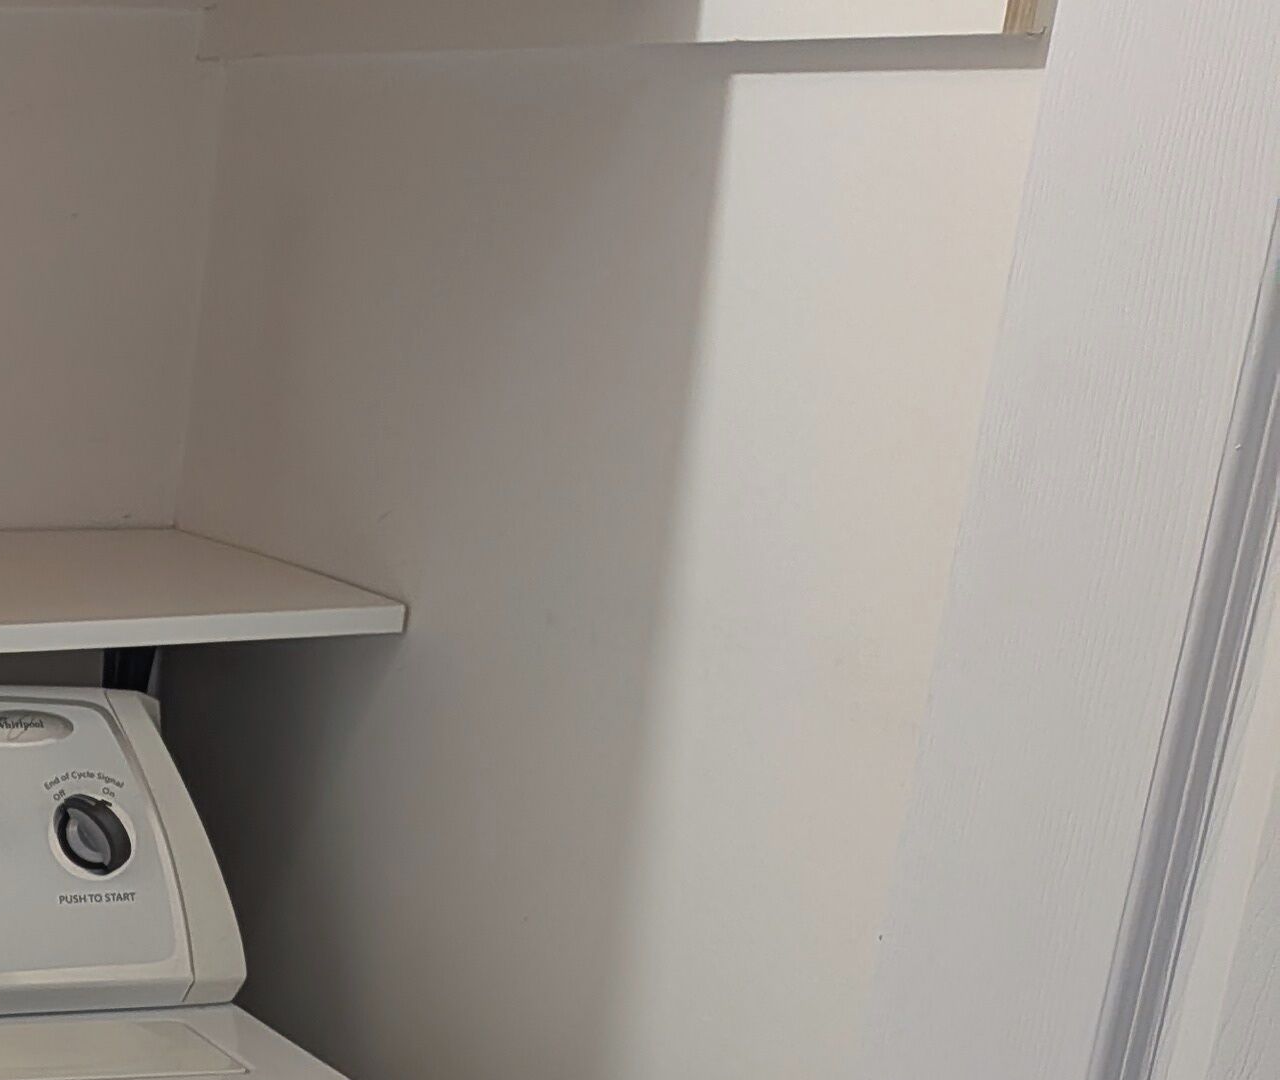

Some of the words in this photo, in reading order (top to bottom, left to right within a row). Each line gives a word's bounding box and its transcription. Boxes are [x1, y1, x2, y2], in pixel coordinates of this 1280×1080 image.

[43, 778, 61, 790] End
[61, 772, 70, 781] of
[71, 771, 95, 781] Cycle
[97, 772, 124, 789] Signal
[53, 789, 66, 801] Off
[102, 786, 116, 798] On
[59, 894, 86, 905] PUSH
[88, 894, 103, 903] TO
[105, 892, 136, 902] START
